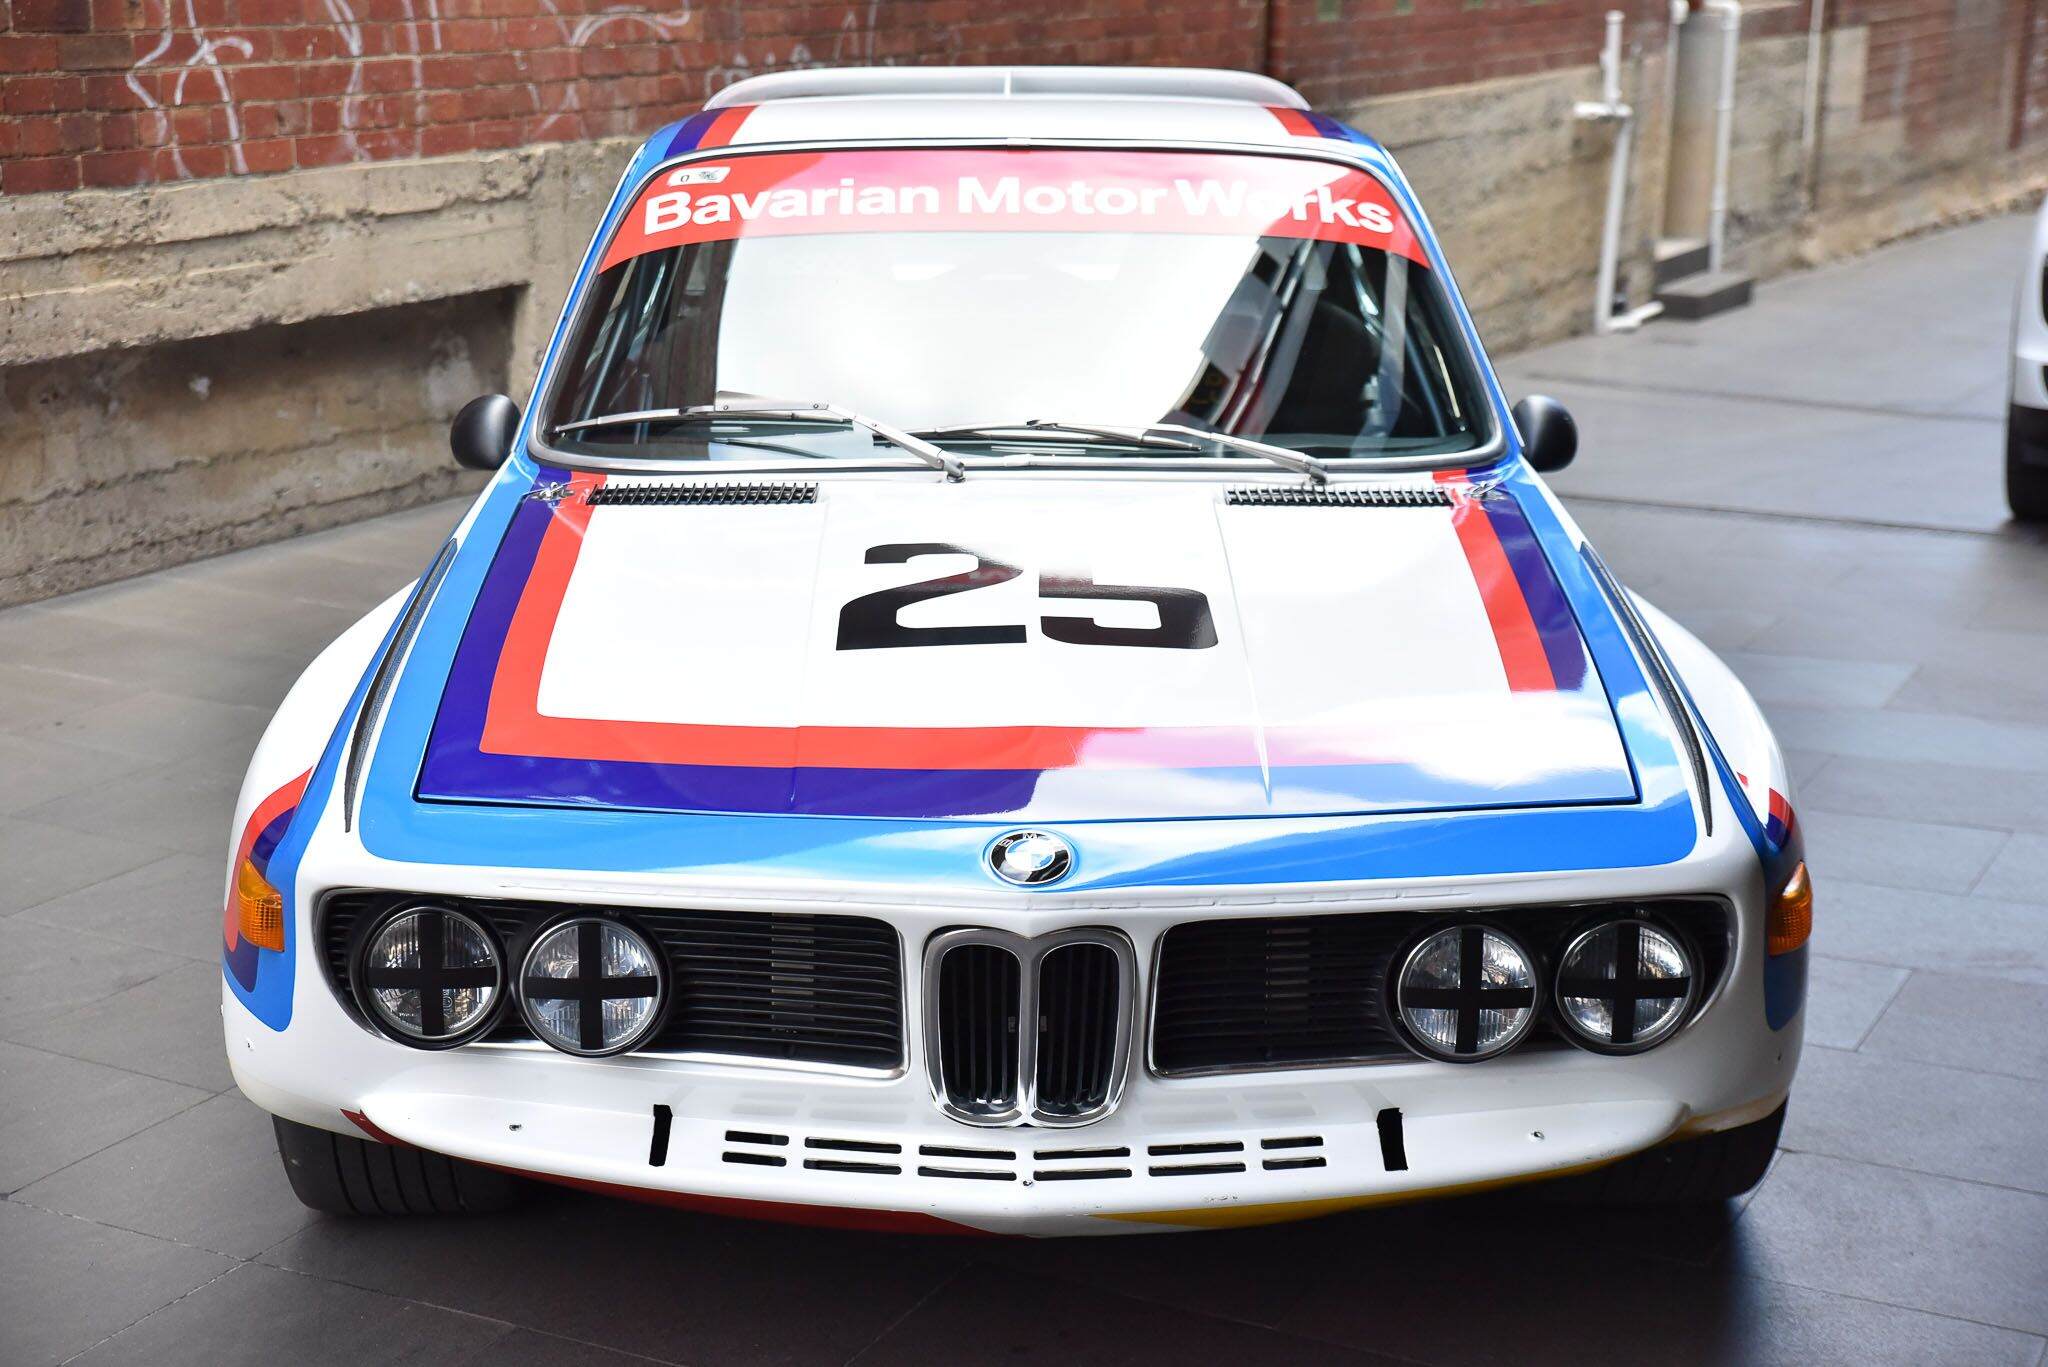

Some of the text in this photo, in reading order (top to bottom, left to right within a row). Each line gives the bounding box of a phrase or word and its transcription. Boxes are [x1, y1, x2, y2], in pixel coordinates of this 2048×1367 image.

[644, 178, 939, 235] Bavarian
[958, 177, 1168, 215] Motor
[836, 543, 1218, 650] 25
